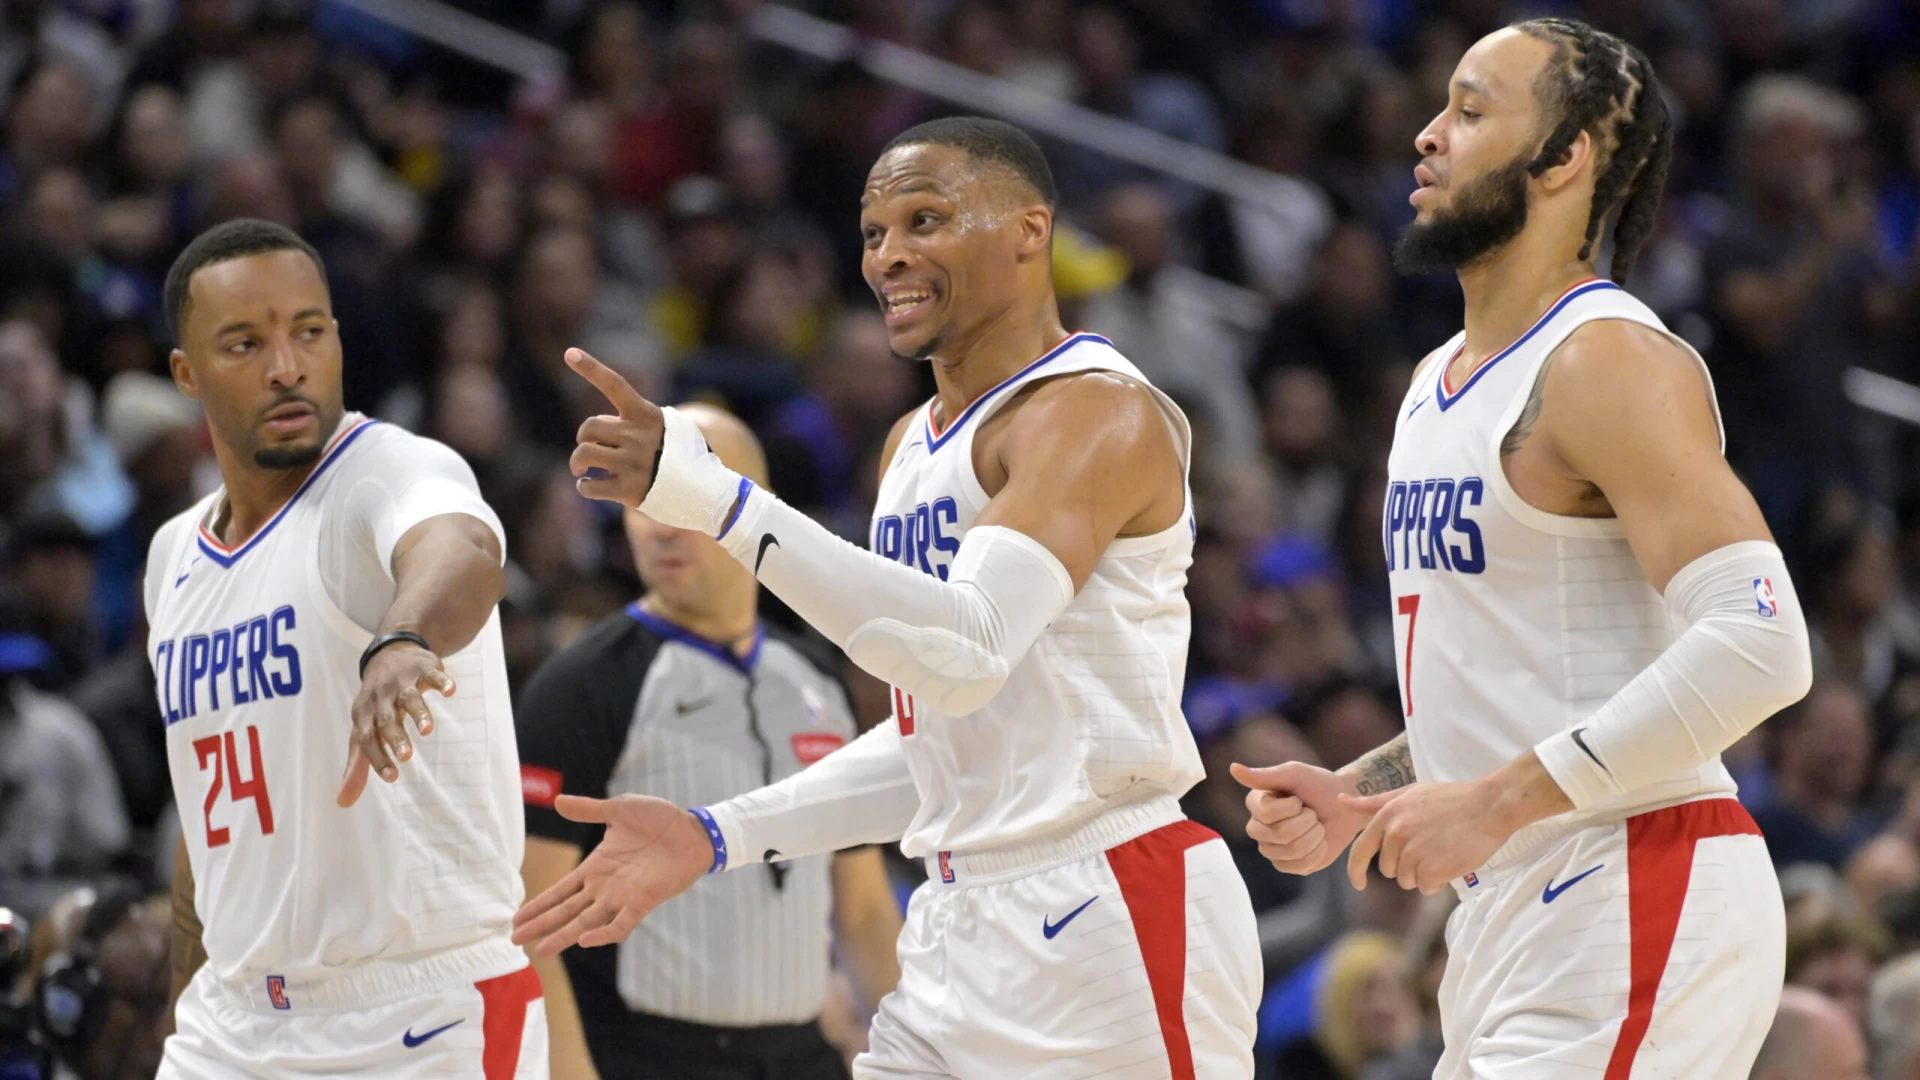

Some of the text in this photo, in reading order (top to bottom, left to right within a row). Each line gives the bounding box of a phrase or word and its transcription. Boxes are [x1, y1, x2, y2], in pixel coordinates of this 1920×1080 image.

[1386, 477, 1485, 574] IPPERS
[156, 605, 301, 727] CLIPPERS
[1398, 594, 1420, 717] 7
[193, 725, 274, 848] 24
